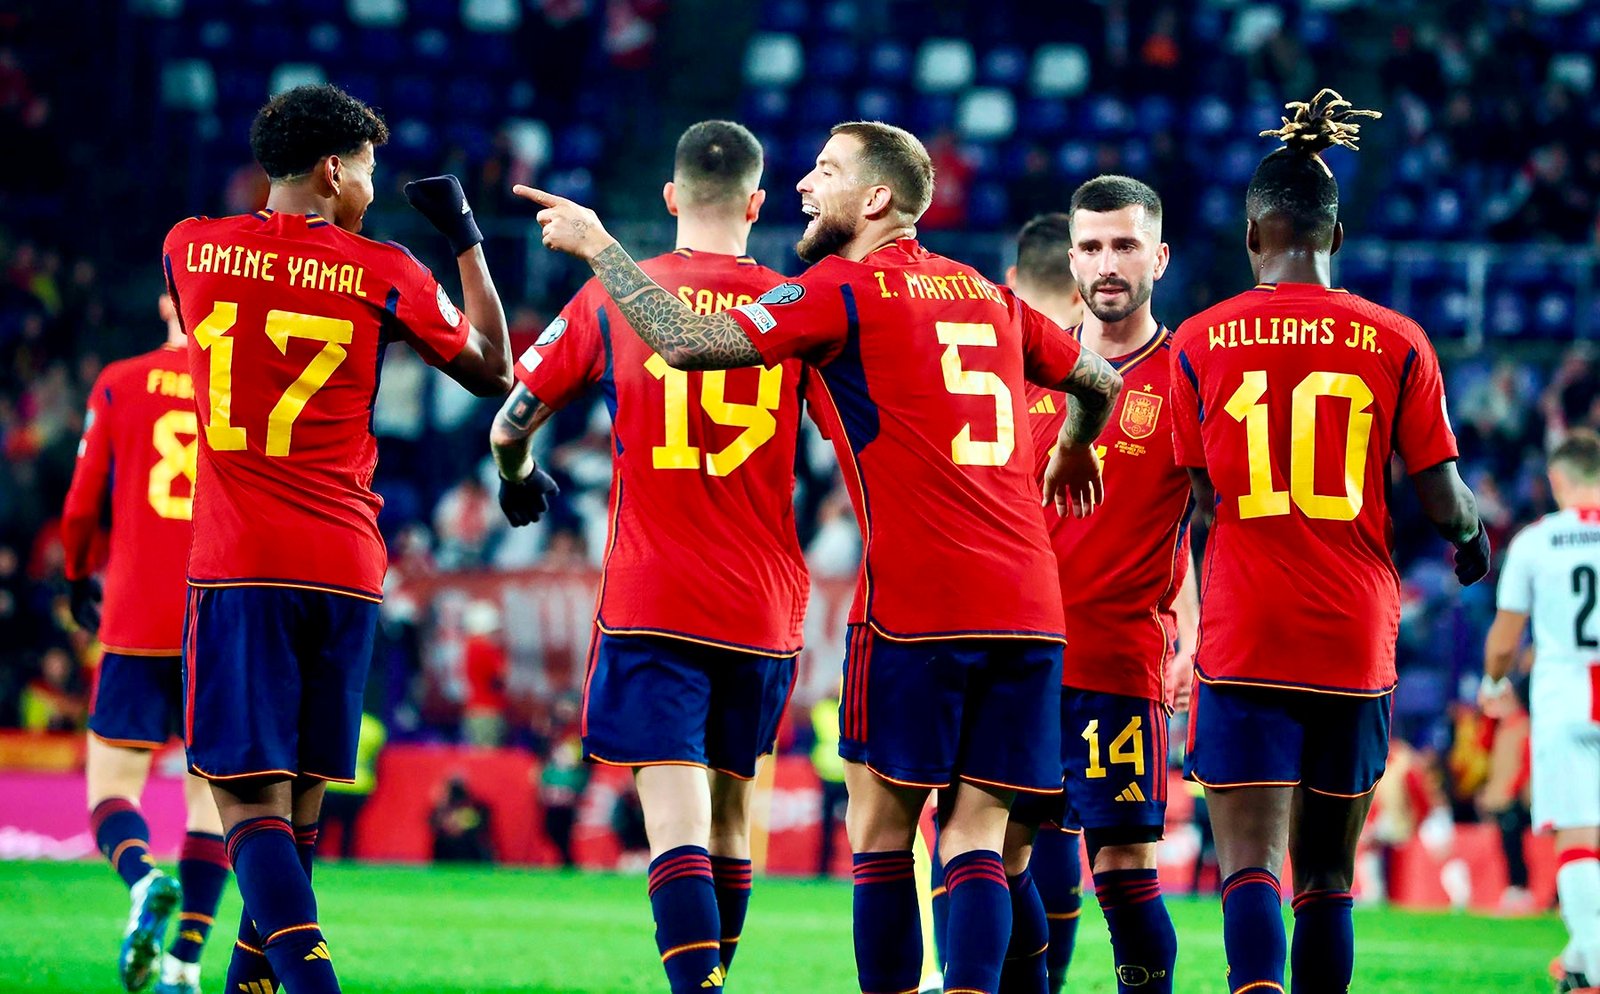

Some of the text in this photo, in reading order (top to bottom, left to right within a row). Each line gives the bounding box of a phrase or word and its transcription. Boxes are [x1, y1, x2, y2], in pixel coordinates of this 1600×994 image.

[186, 243, 367, 297] LAMINE YAMAL
[874, 271, 899, 299] I.
[193, 301, 354, 457] 17
[1208, 317, 1383, 355] WILLIAMS JR.
[643, 352, 783, 477] 19
[935, 321, 1015, 467] 5
[148, 409, 199, 521] 8
[1223, 370, 1374, 521] 10
[1571, 564, 1599, 648] 2
[1081, 716, 1145, 779] 14
